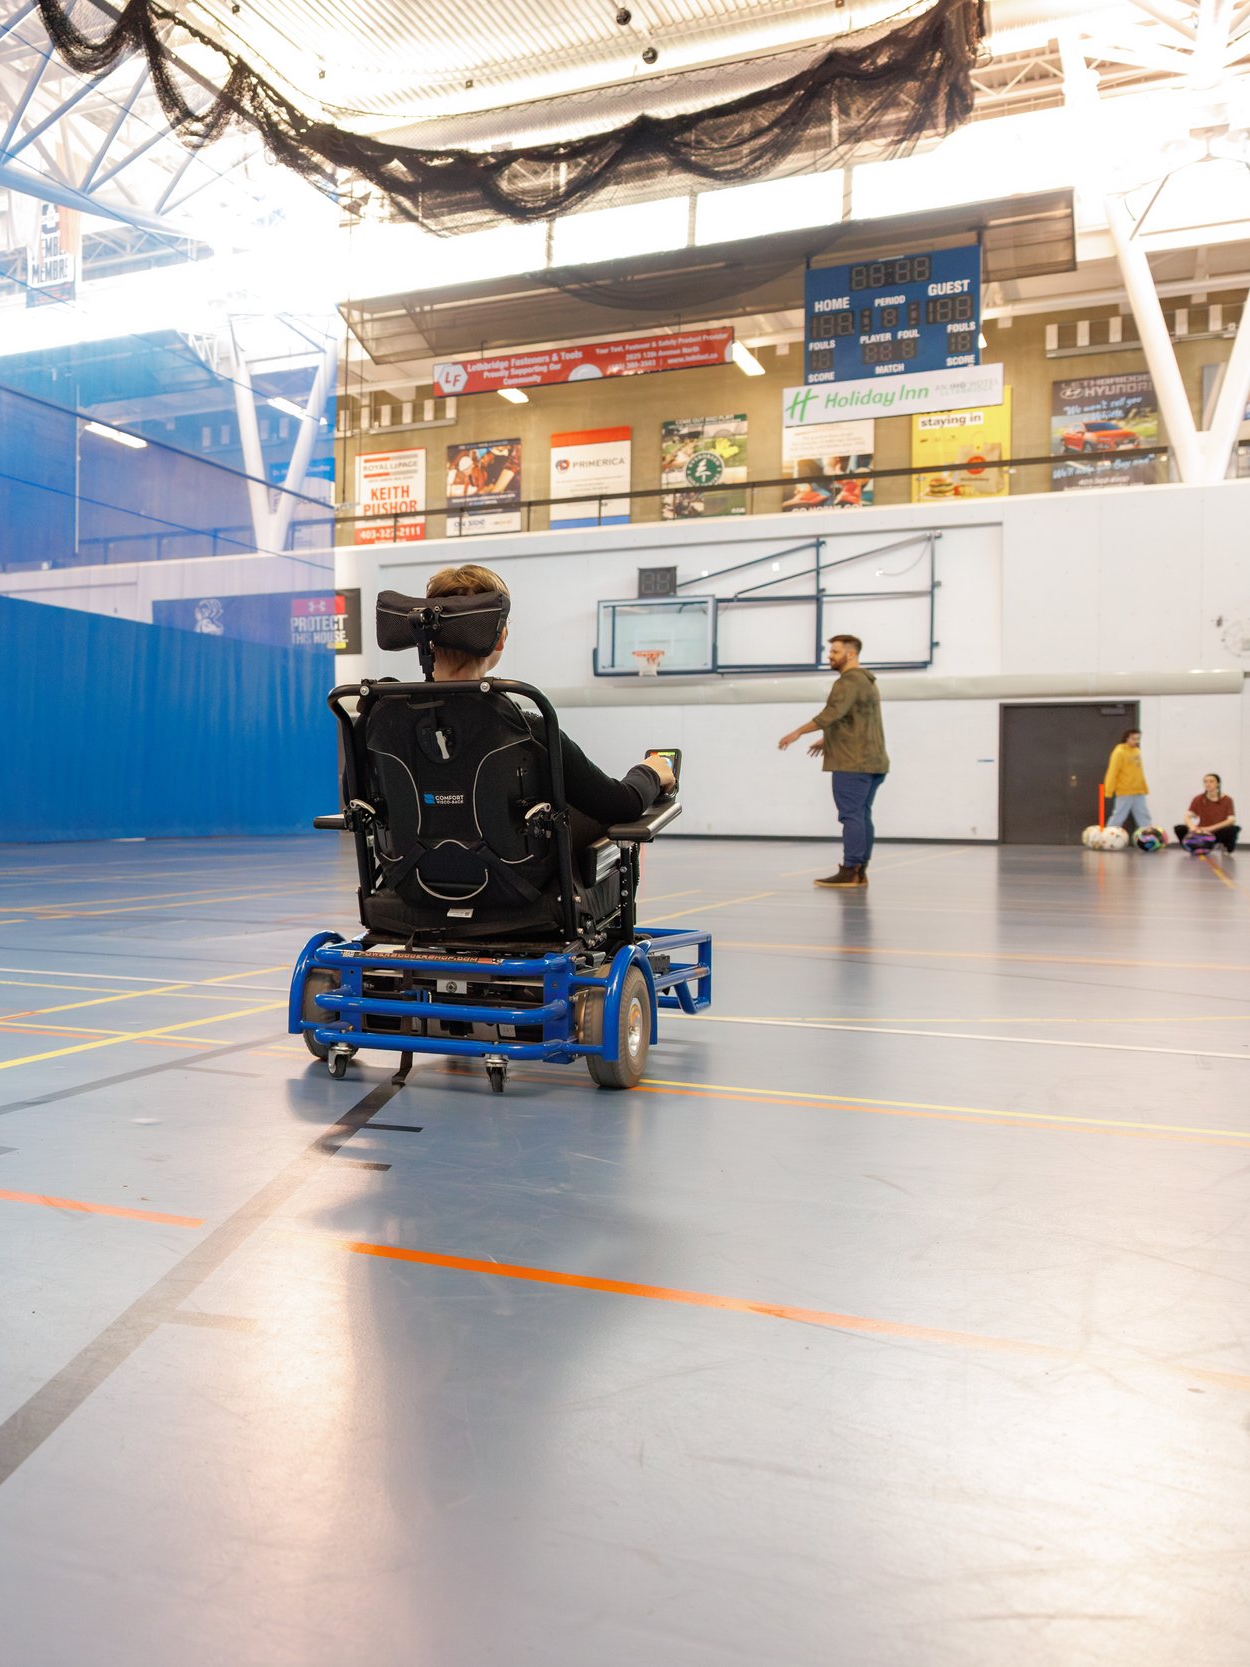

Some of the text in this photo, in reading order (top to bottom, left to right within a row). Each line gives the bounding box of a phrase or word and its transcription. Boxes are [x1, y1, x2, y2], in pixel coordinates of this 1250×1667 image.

[928, 279, 970, 296] GUEST
[814, 297, 850, 312] HOME
[874, 295, 906, 307] PERIOD
[946, 321, 976, 333] FOULS
[860, 329, 920, 344] PLAYER FOUL
[809, 340, 836, 351] FOULS
[467, 350, 583, 373] Lethbridge Fasteners & Tools
[946, 355, 976, 366] SCORE
[510, 364, 548, 375] Supporting
[875, 363, 905, 374] MATCH
[808, 371, 835, 383] SCORE
[825, 389, 896, 409] Holiday
[899, 384, 930, 400] Inn
[920, 412, 982, 429] staying in
[363, 463, 389, 472] ROYAL
[572, 457, 625, 470] PRIMERICA
[370, 485, 410, 500] KEITH
[363, 500, 417, 515] PUSHOR
[291, 614, 349, 632] PROTECT
[291, 632, 312, 644] THIS
